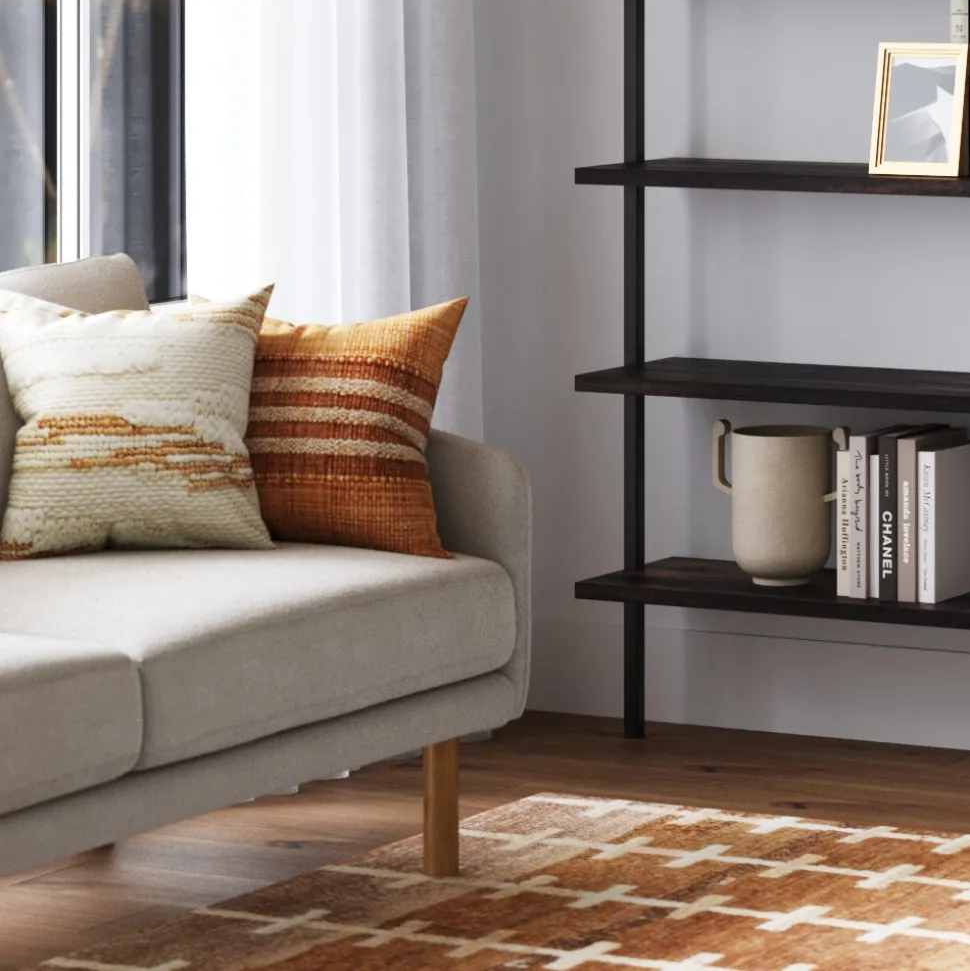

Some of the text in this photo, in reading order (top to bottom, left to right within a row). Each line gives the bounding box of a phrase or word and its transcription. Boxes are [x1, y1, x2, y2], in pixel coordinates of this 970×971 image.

[852, 450, 863, 469] The
[841, 477, 850, 571] Arianna Huffington
[882, 510, 893, 579] CHANEL
[902, 480, 911, 564] amanda lovelace
